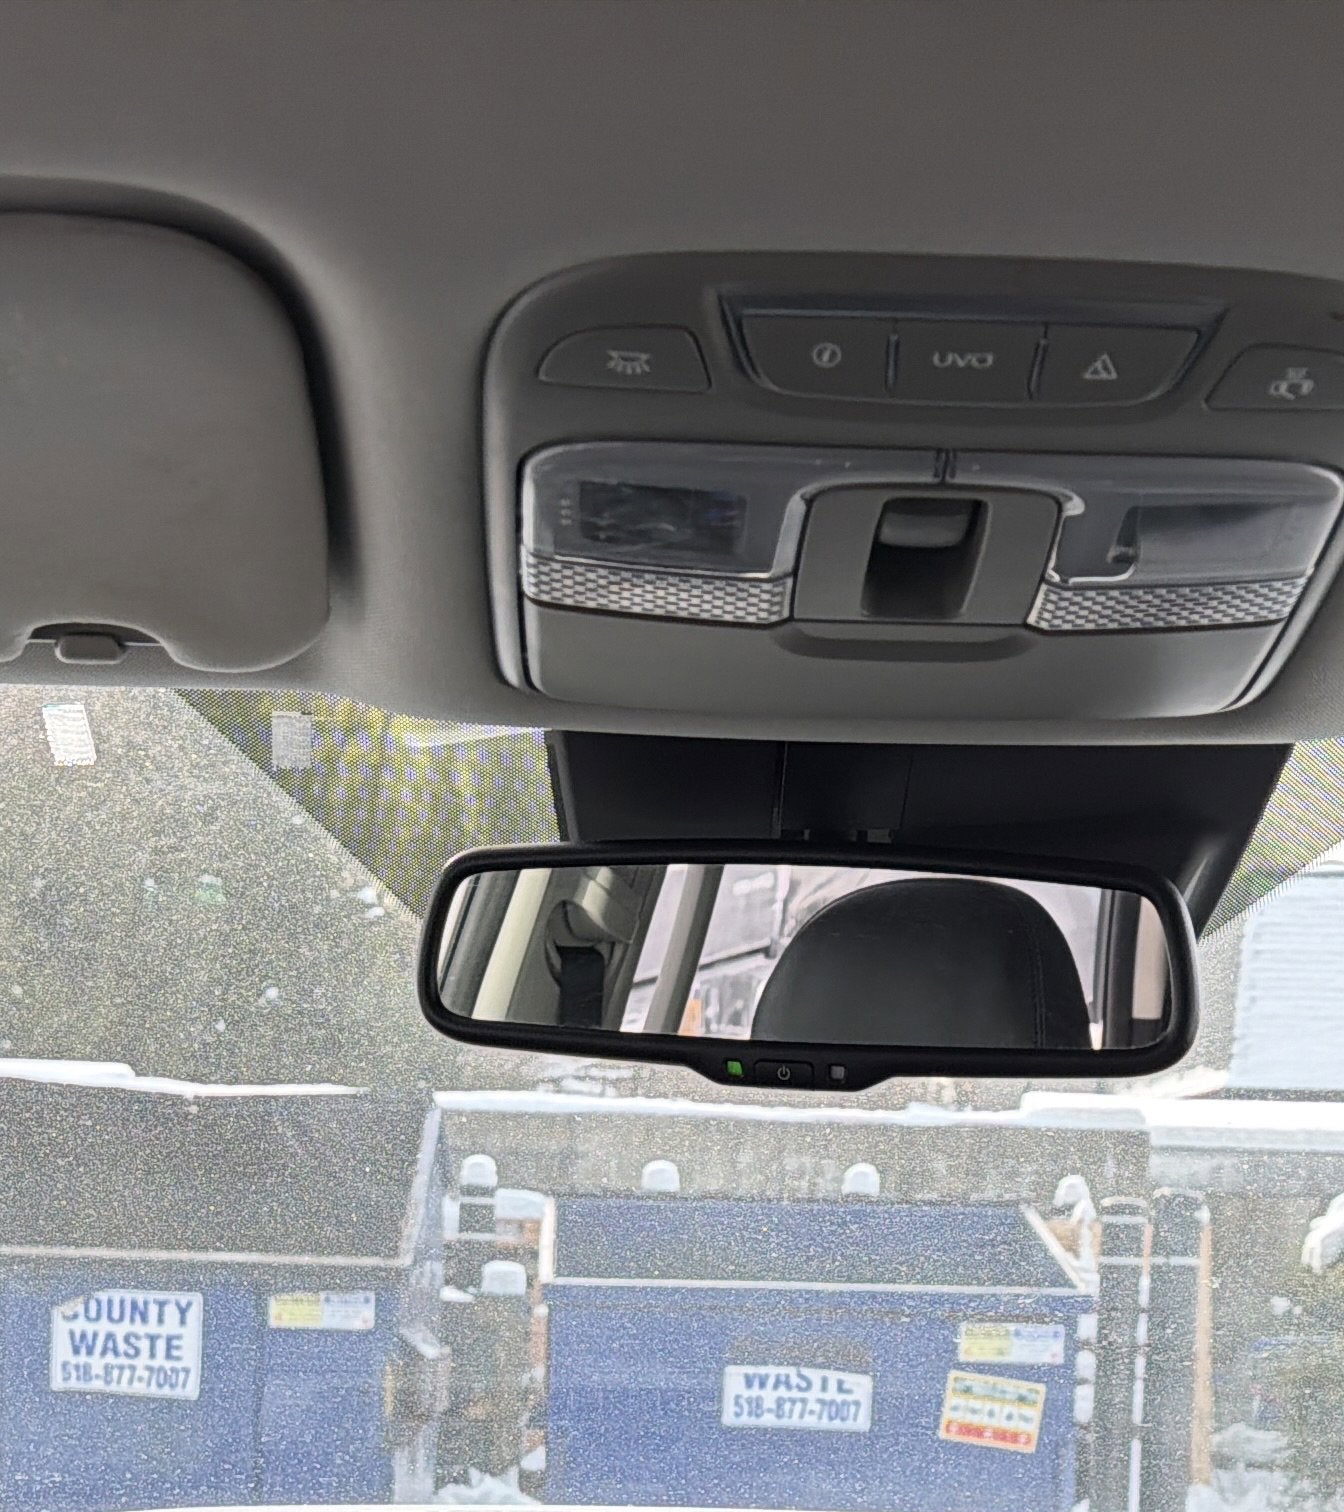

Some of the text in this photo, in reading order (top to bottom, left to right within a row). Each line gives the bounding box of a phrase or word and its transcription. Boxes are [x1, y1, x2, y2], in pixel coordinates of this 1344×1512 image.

[933, 351, 993, 368] UVO
[68, 1329, 184, 1361] WASTE
[60, 1363, 192, 1390] 518-877-7007
[732, 1394, 862, 1422] 518-877-7007
